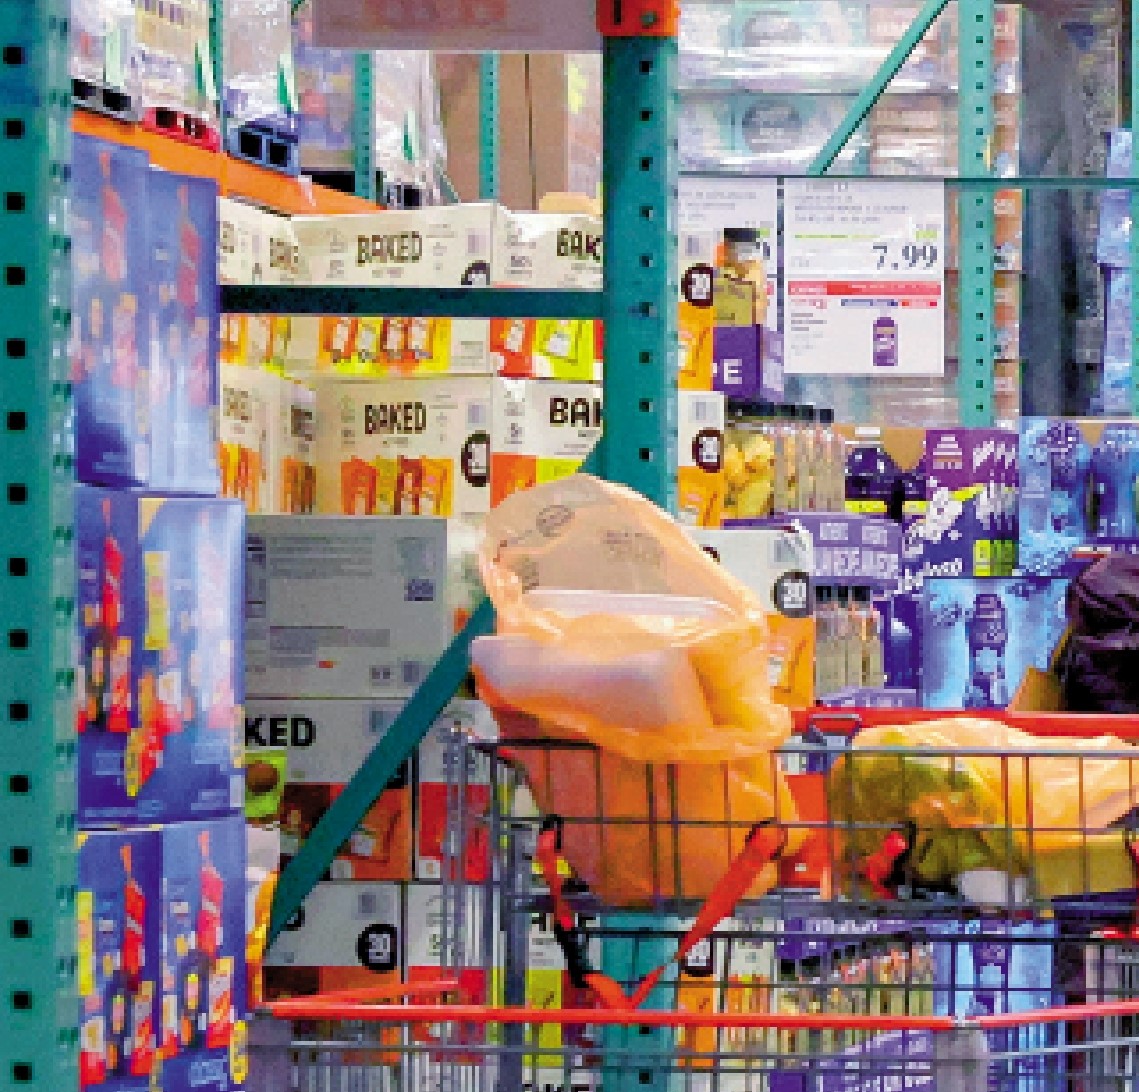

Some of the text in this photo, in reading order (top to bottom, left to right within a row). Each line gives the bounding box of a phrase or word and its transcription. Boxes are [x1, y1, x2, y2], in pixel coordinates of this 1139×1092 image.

[357, 231, 422, 264] BAKED
[557, 228, 601, 262] BAK
[873, 245, 937, 270] 7.99
[365, 401, 426, 435] BAKED
[245, 716, 316, 748] KED
